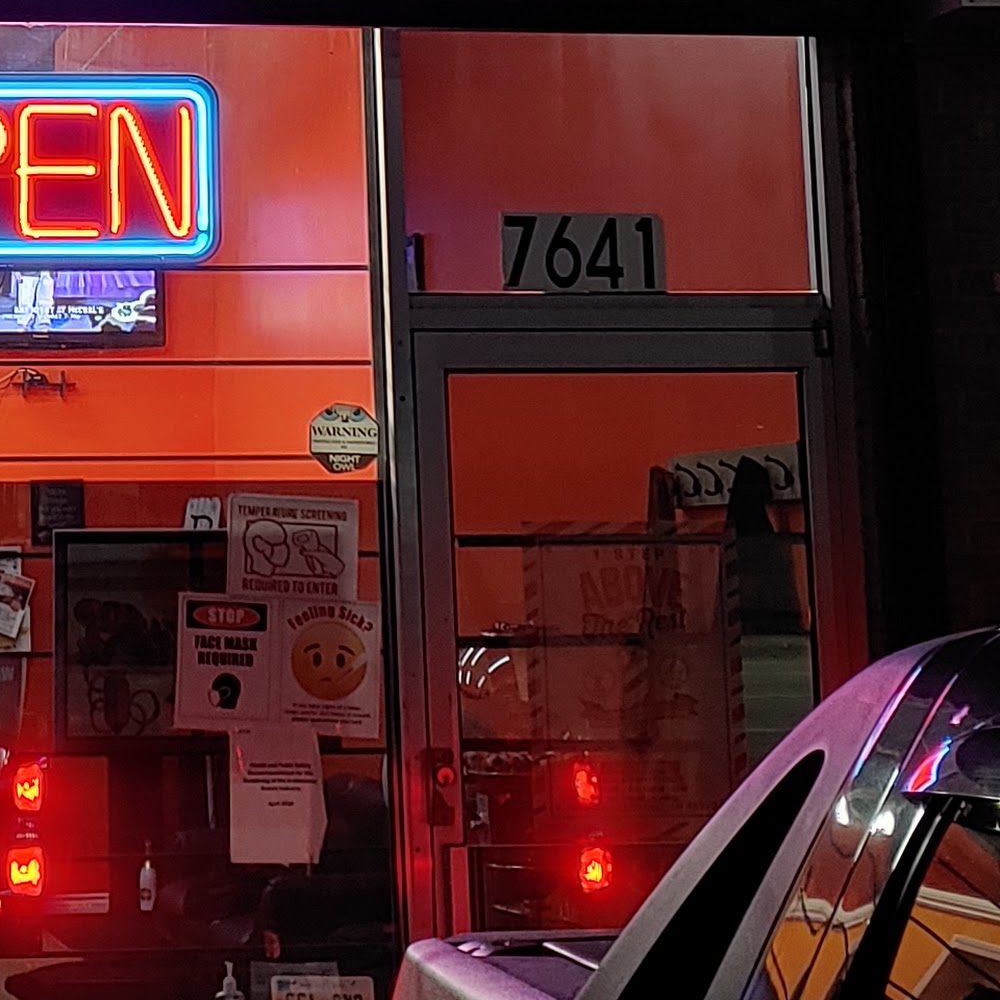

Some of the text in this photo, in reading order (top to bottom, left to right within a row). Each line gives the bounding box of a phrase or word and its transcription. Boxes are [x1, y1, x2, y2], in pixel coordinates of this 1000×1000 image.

[502, 215, 657, 289] 7641
[311, 425, 377, 438] WARNING
[328, 454, 362, 464] NIGHT
[332, 462, 356, 471] OWL
[237, 504, 347, 522] TEMPERATURE SCREENING
[241, 576, 338, 596] REQUIRED TO ENTER
[207, 606, 245, 624] STOP
[287, 605, 374, 632] Feeling Sick?
[194, 634, 258, 652] FACE MASK
[197, 651, 254, 668] REQUIRED
